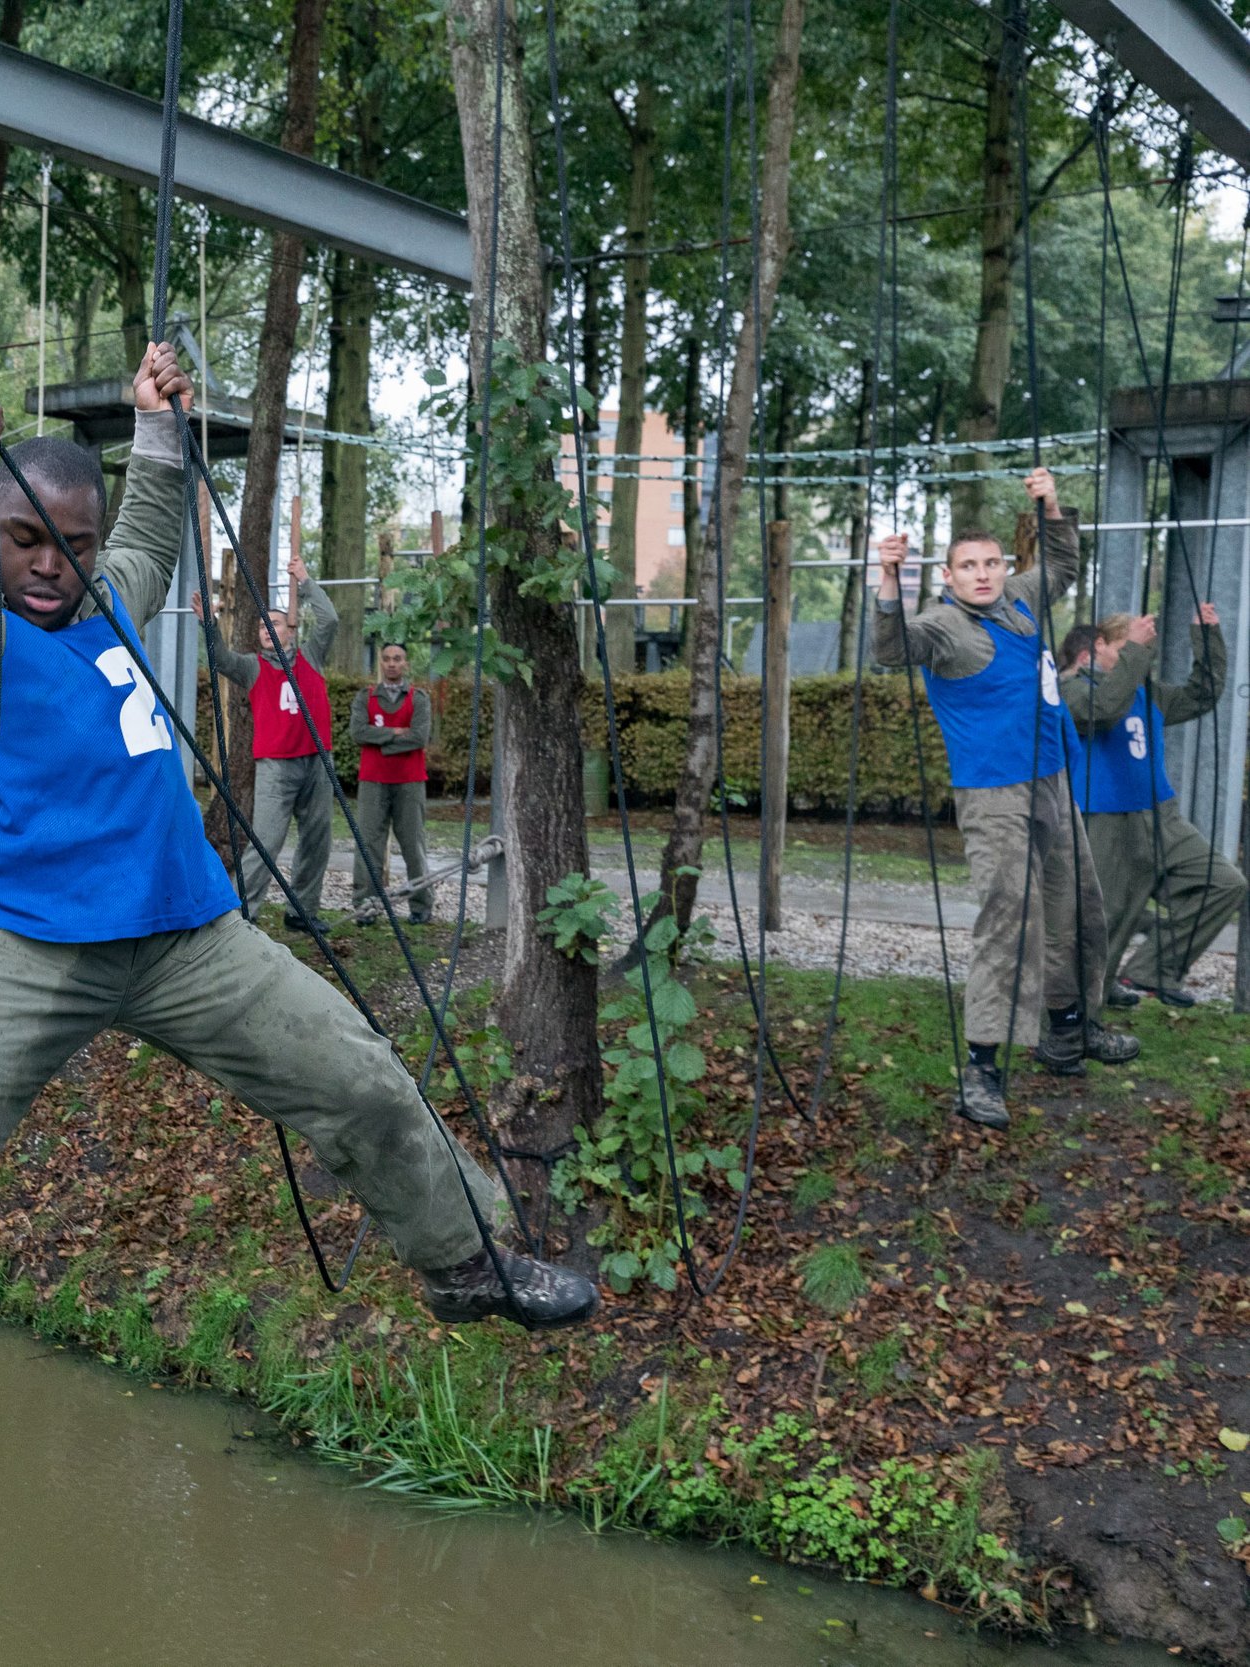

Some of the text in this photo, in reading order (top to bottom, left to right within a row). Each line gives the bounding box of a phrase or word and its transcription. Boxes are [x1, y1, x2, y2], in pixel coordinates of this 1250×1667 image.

[94, 645, 173, 757] 2
[279, 680, 300, 714] 4
[374, 714, 384, 727] 3
[1125, 716, 1147, 760] 3
